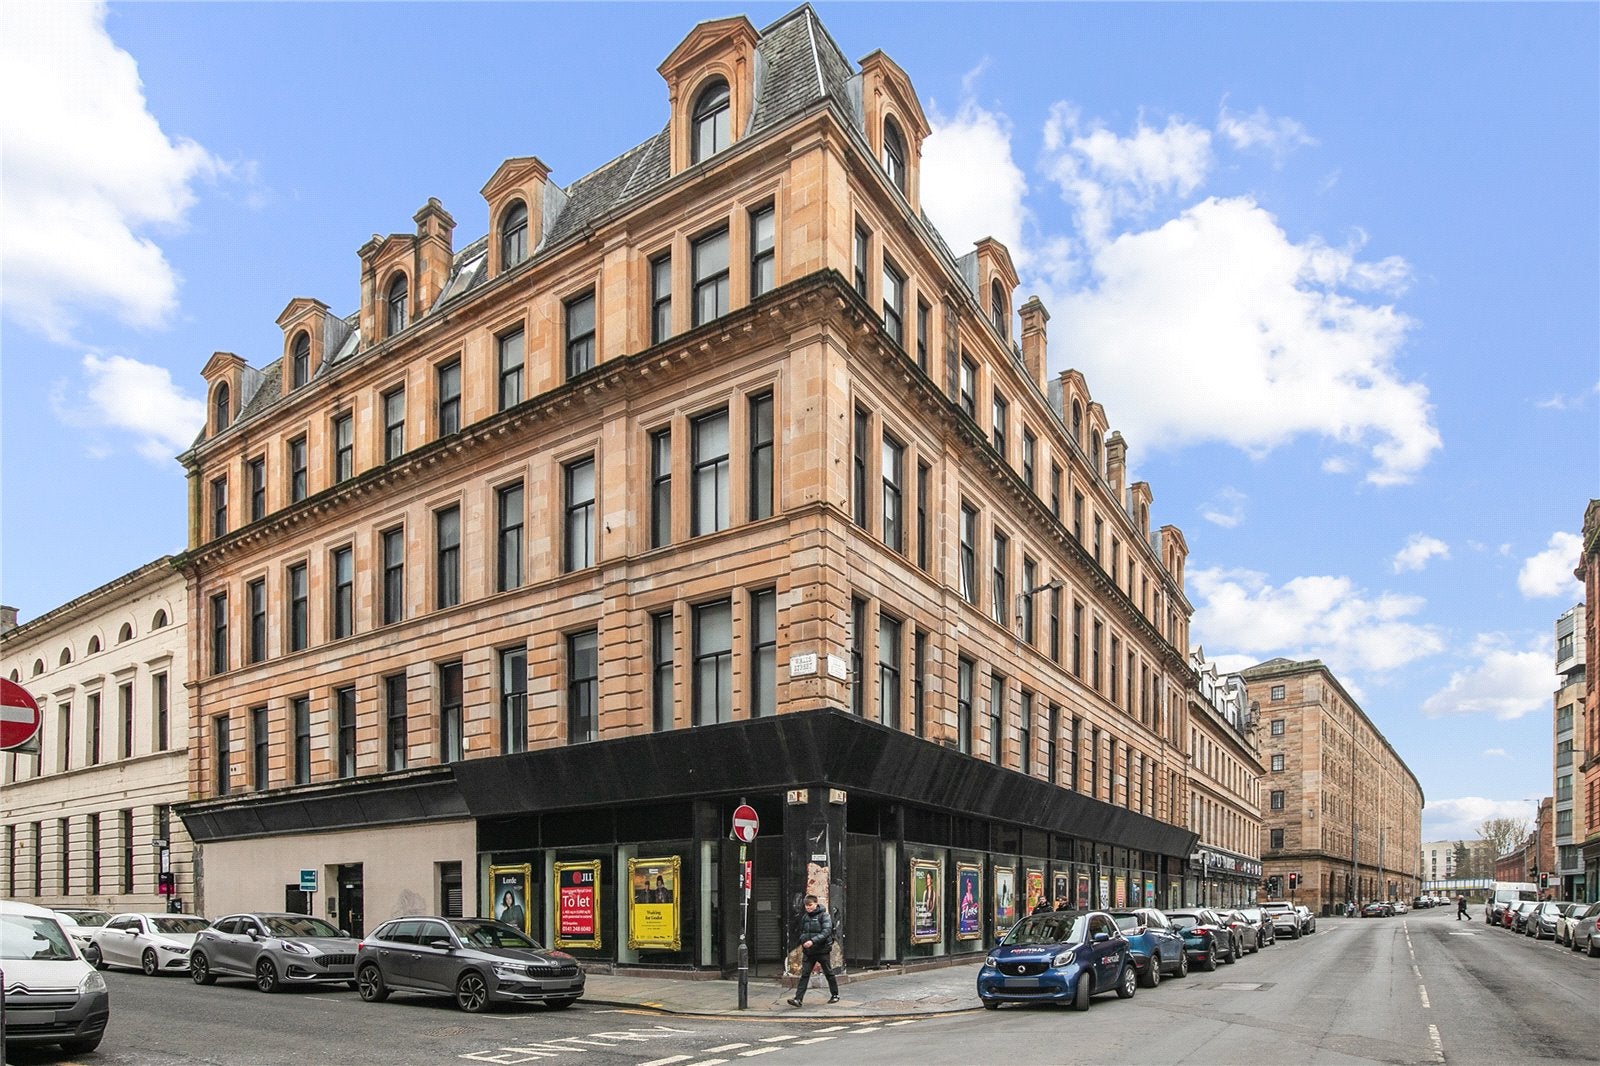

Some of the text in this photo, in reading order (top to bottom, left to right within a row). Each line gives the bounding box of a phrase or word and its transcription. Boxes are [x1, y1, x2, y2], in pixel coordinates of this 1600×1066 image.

[581, 872, 593, 882] JLL
[562, 894, 590, 908] To let
[458, 1026, 696, 1065] ENTRY
